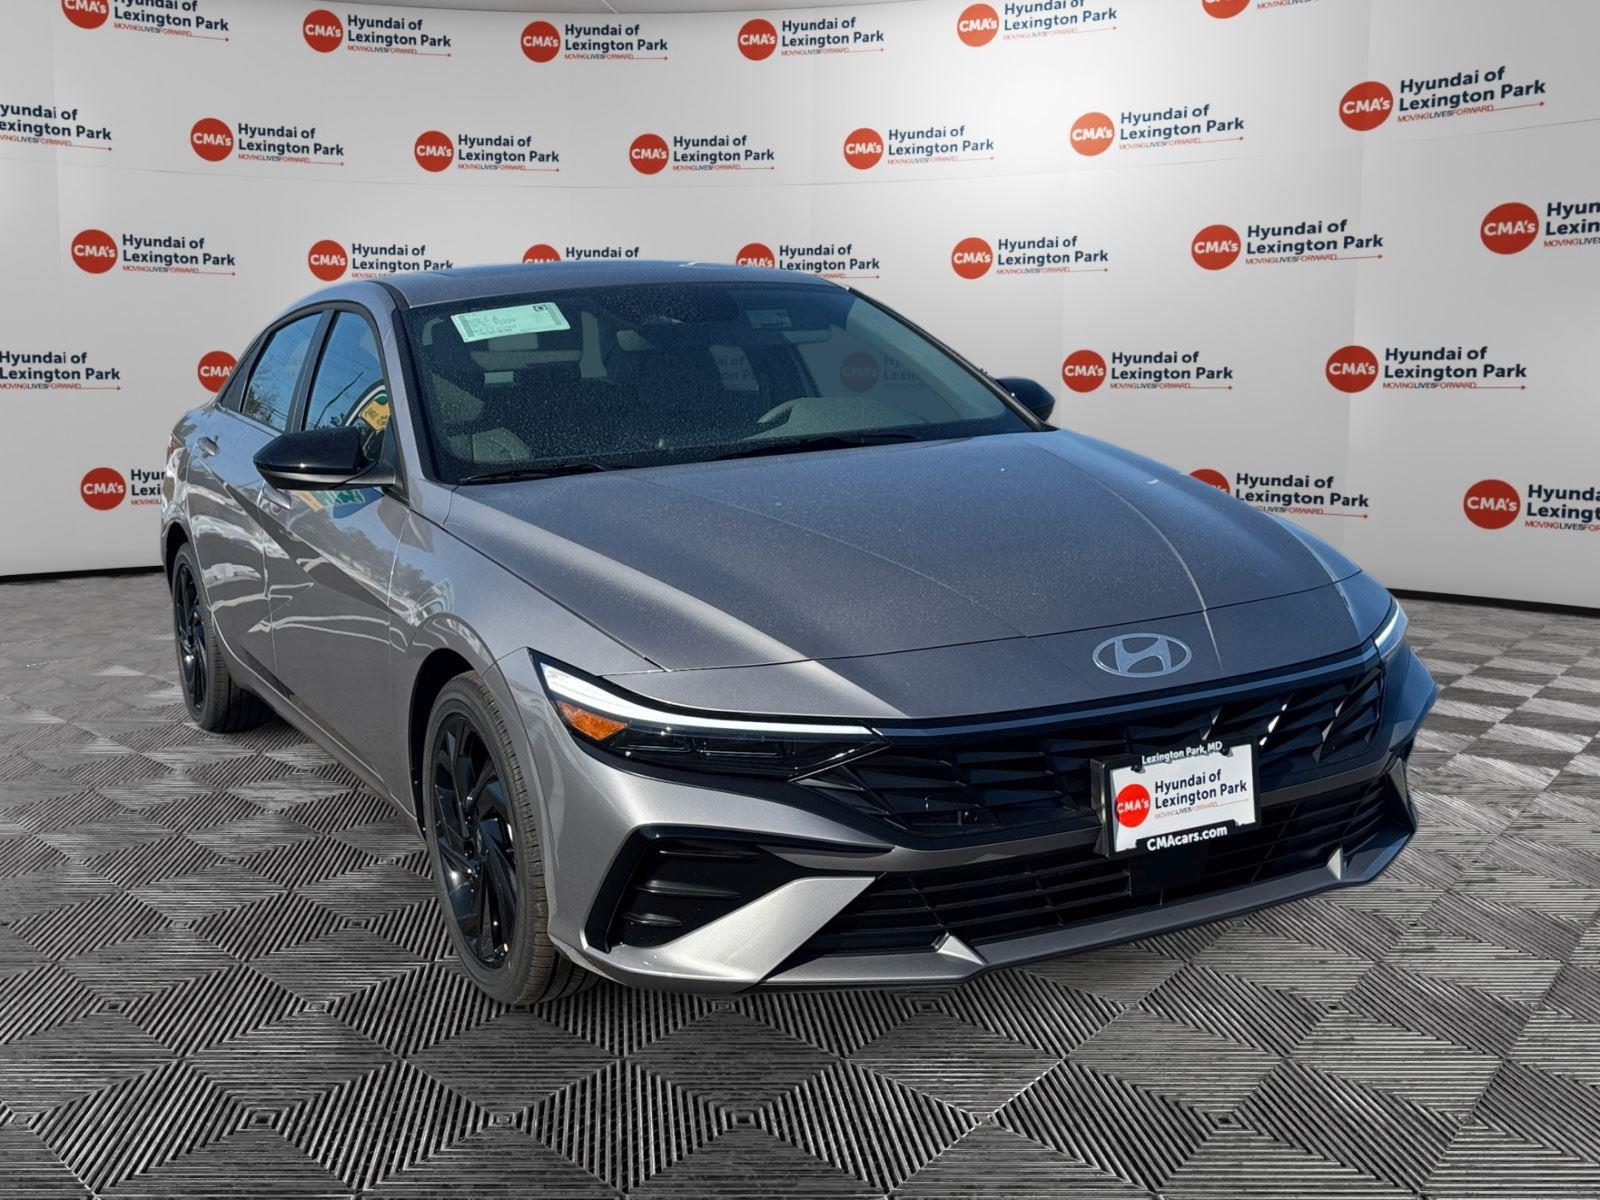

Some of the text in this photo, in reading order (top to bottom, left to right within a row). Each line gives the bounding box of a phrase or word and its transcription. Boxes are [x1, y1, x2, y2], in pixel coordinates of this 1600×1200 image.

[182, 0, 198, 12] of
[1005, 0, 1066, 17] Hyundai
[115, 7, 229, 31] Lexington Park
[348, 15, 422, 30] Hyundai of
[782, 17, 856, 35] Hyundai of
[959, 19, 997, 32] CMA's
[1005, 8, 1117, 30] Lexington Park
[304, 24, 341, 37] CMA's
[565, 24, 639, 38] Hyundai of
[348, 31, 451, 48] Lexington Park
[523, 36, 559, 48] CMA's
[565, 38, 667, 53] Lexington Park
[739, 34, 775, 46] CMA's
[782, 30, 884, 49] Lexington Park
[1401, 66, 1506, 94] Hyundai of
[1399, 80, 1546, 112] Lexington Park
[0, 104, 78, 120] yundai of
[1343, 96, 1390, 116] CMA's
[1398, 105, 1494, 122] MOVINGLIVESFORWARD
[1120, 104, 1210, 125] Hyundai of
[0, 119, 112, 140] exington Park
[238, 123, 316, 139] Hyundai of
[888, 126, 965, 142] Hyundai of
[1072, 127, 1113, 141] CMA's
[1120, 117, 1245, 142] Lexington Park
[192, 133, 232, 146] CMA's
[238, 138, 344, 156] Lexington Park
[458, 134, 531, 148] Hyundai of
[674, 135, 747, 149] Hyundai of
[416, 145, 452, 157] CMA's
[631, 148, 667, 159] CMA's
[845, 142, 882, 154] CMA's
[888, 139, 994, 156] Lexington Park
[458, 149, 559, 163] Lexington Park
[674, 149, 774, 163] Lexington Park
[1547, 202, 1600, 219] Hyun
[1248, 219, 1348, 241] Hyundai of
[1484, 220, 1536, 236] CMA's
[1546, 219, 1600, 235] Lexin
[123, 234, 204, 251] Hyundai of
[352, 243, 426, 257] Hyundai of
[998, 236, 1077, 252] Hyundai of
[1194, 240, 1238, 254] CMA's
[1247, 234, 1383, 257] Lexington Park
[74, 244, 115, 258] CMA's
[123, 249, 235, 267] Lexington Park
[566, 247, 639, 259] Hyundai of
[780, 244, 852, 259] Hyundai of
[954, 252, 991, 264] CMA's
[998, 250, 1108, 267] Lexington Park
[310, 255, 346, 266] CMA's
[352, 259, 453, 273] Lexington Park
[780, 258, 879, 273] Lexington Park
[1245, 253, 1337, 265] MOVINGLIVESFORWARD
[0, 351, 87, 366] Hyundai of
[1112, 351, 1199, 367] Hyundai of
[1385, 346, 1487, 364] Hyundai of
[0, 367, 120, 382] Lexington Park
[200, 366, 232, 377] CMA'
[1065, 364, 1104, 377] CMA's
[1111, 365, 1233, 382] Lexington Park
[1329, 361, 1376, 376] CMA's
[1384, 364, 1527, 381] Lexington Park
[1383, 381, 1477, 389] MOVINGLIVESFORWARD
[1236, 473, 1334, 488] Hyundai of
[84, 483, 123, 494] CMA's
[1236, 489, 1368, 507] Lexington Park
[1467, 496, 1517, 511] CMA's
[1527, 502, 1600, 523] Lexingt
[1142, 748, 1184, 765] Lexington
[1207, 741, 1222, 751] MD
[1155, 769, 1221, 795] Hyundai of
[1155, 781, 1247, 809] Lexington Park
[1117, 799, 1149, 813] CMA's
[1147, 826, 1228, 851] CMAcars.com
